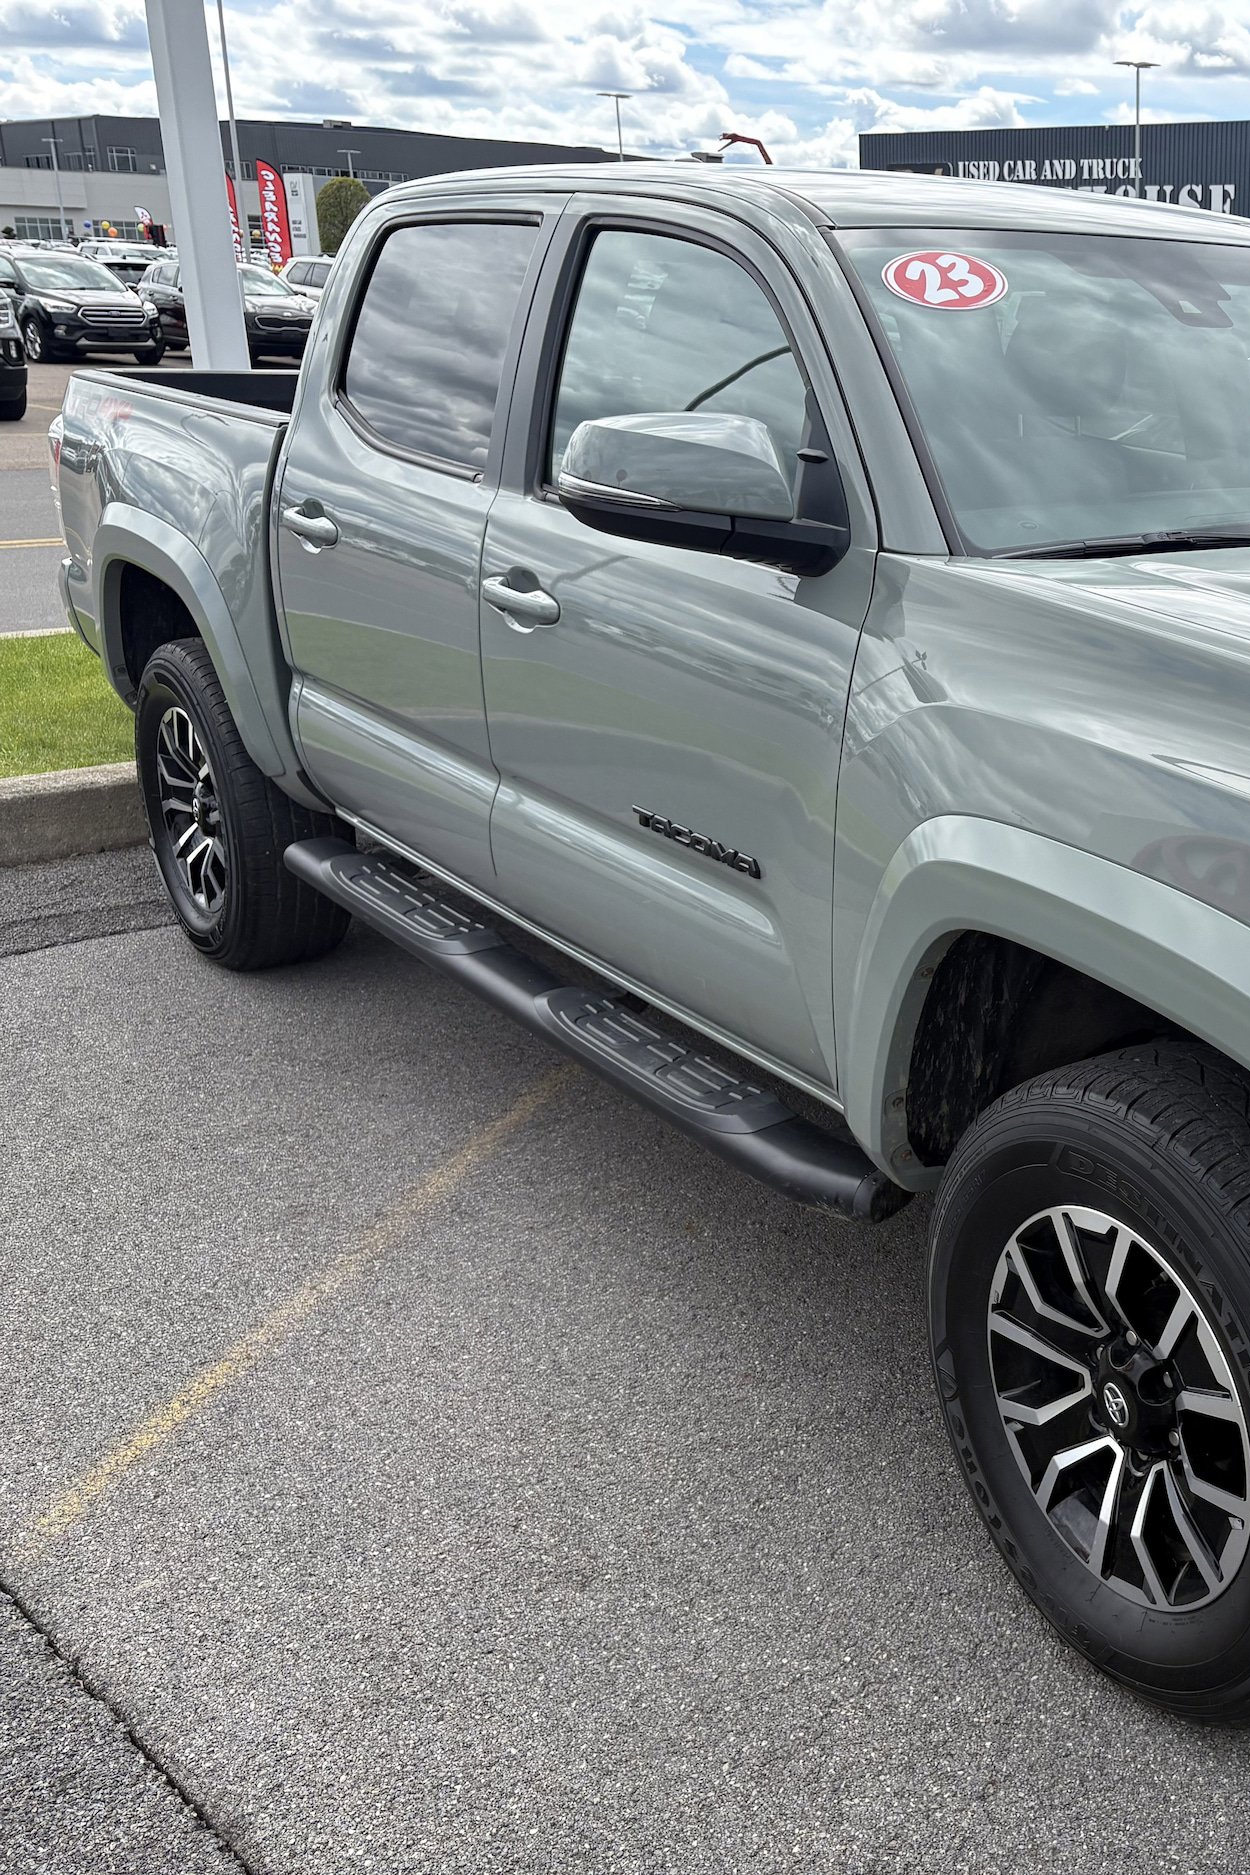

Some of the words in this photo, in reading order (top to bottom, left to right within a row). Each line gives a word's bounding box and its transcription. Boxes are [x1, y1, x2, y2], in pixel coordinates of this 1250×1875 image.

[958, 161, 1000, 181] USED
[1003, 160, 1037, 182] CAR
[1041, 159, 1076, 180] AND
[1080, 158, 1143, 180] TRUCK
[905, 254, 984, 304] 23
[632, 804, 761, 879] TACOMA
